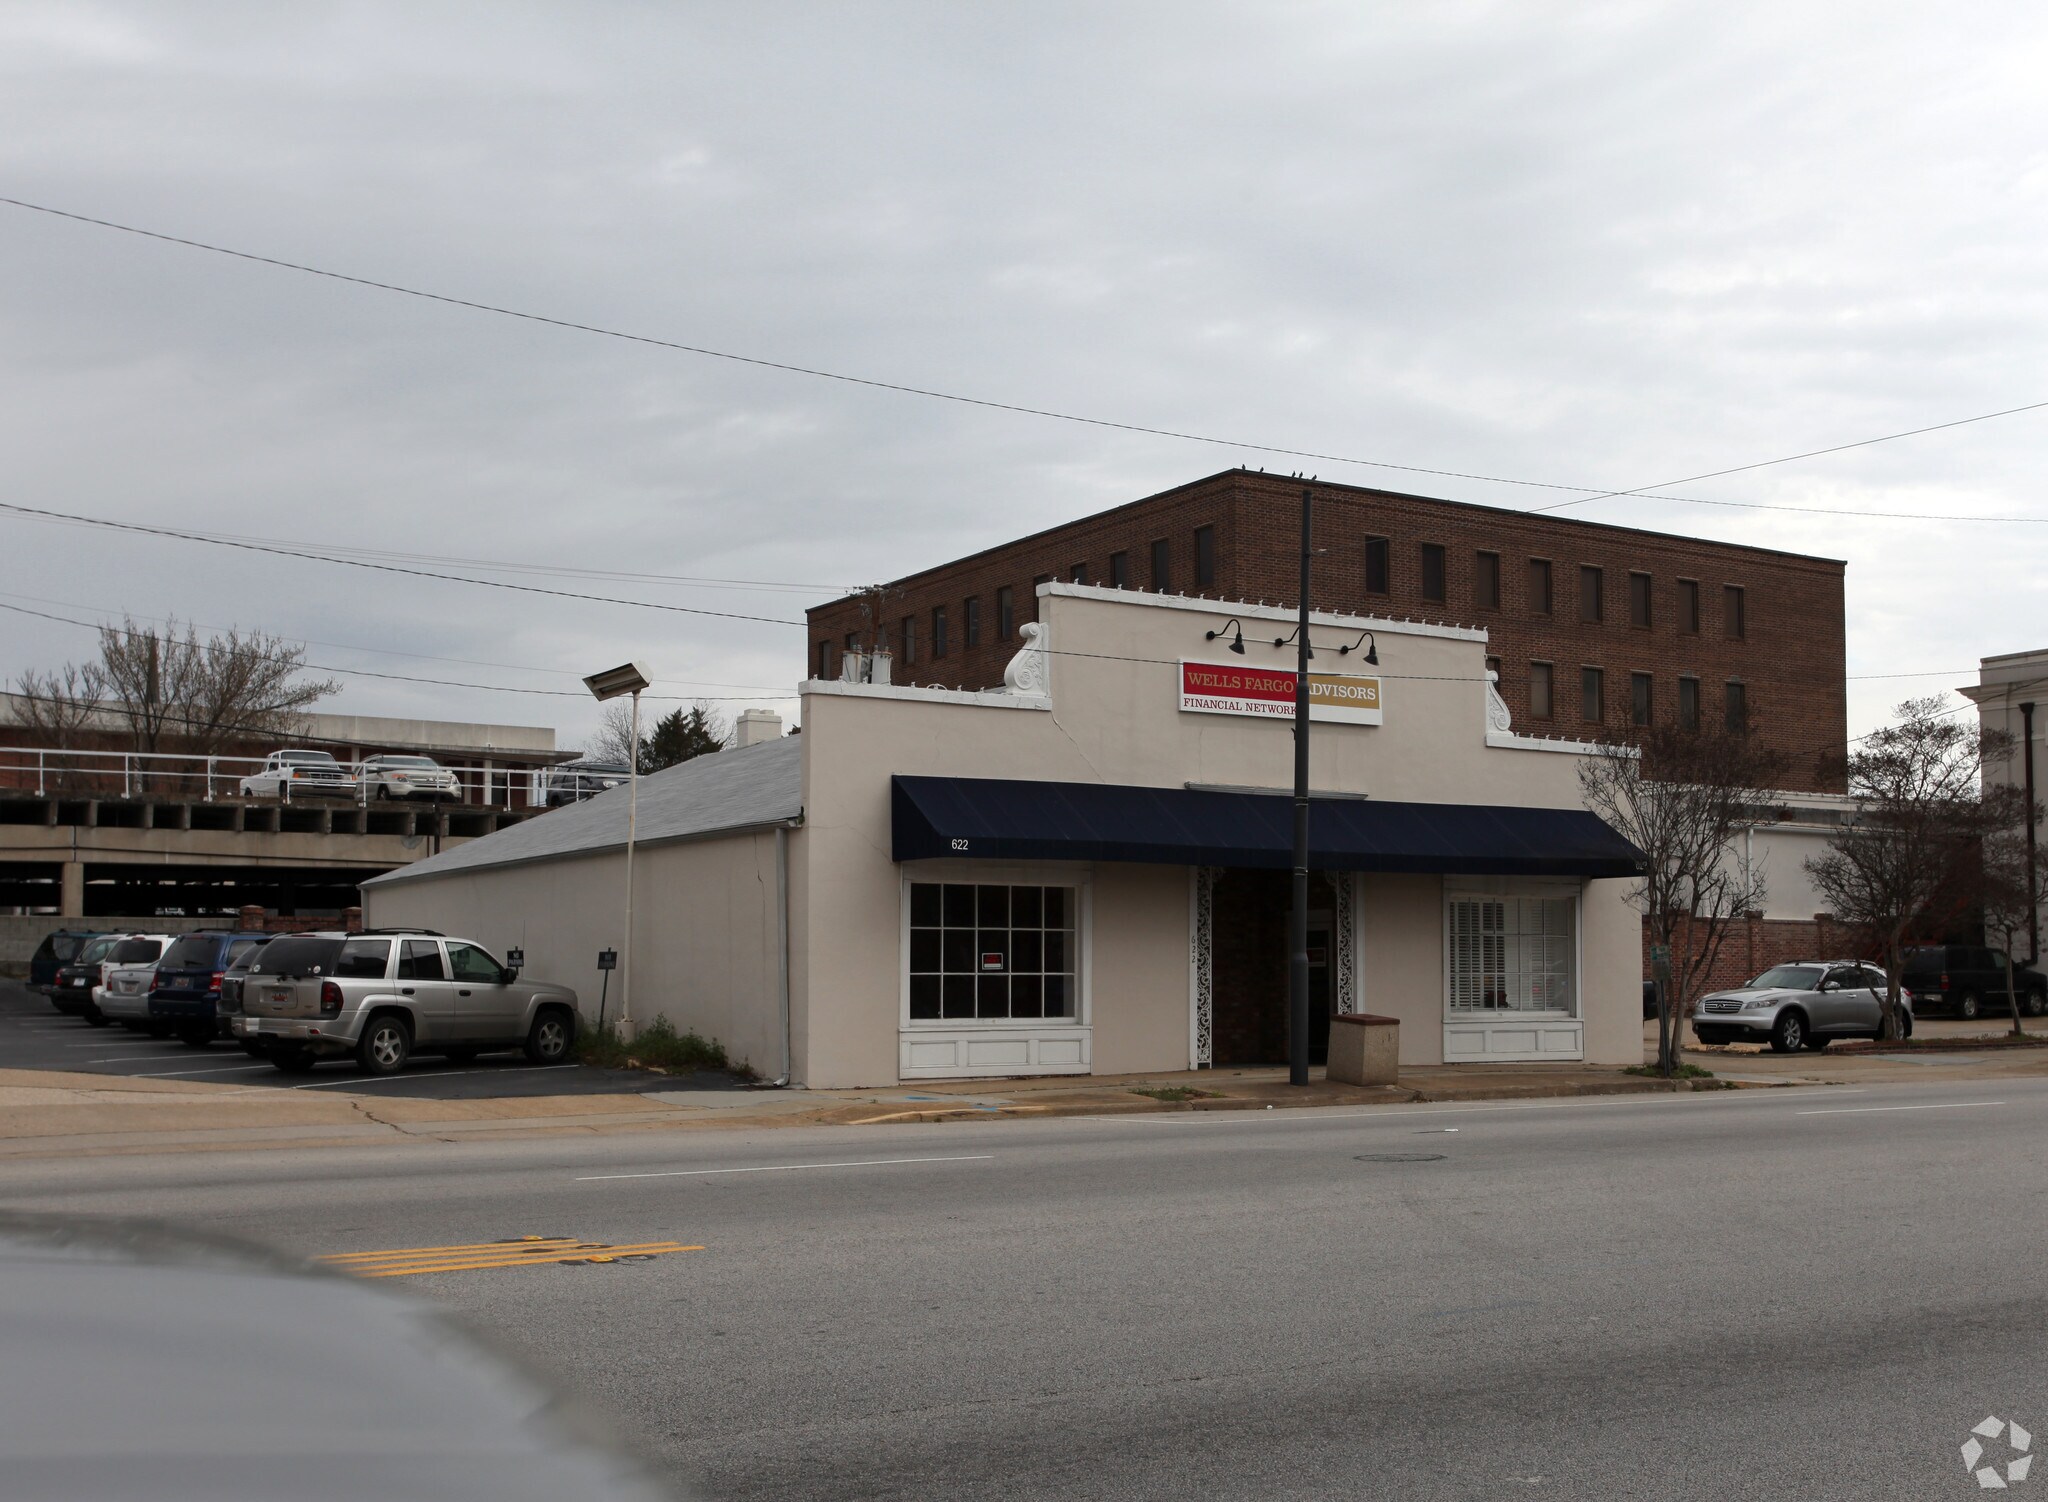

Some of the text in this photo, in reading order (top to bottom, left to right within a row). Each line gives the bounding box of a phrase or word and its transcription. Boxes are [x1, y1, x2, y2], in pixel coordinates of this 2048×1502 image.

[1187, 672, 1241, 689] WELLS
[1245, 677, 1294, 693] FARGO
[1183, 698, 1242, 711] FINANCIAL
[951, 838, 969, 850] 622
